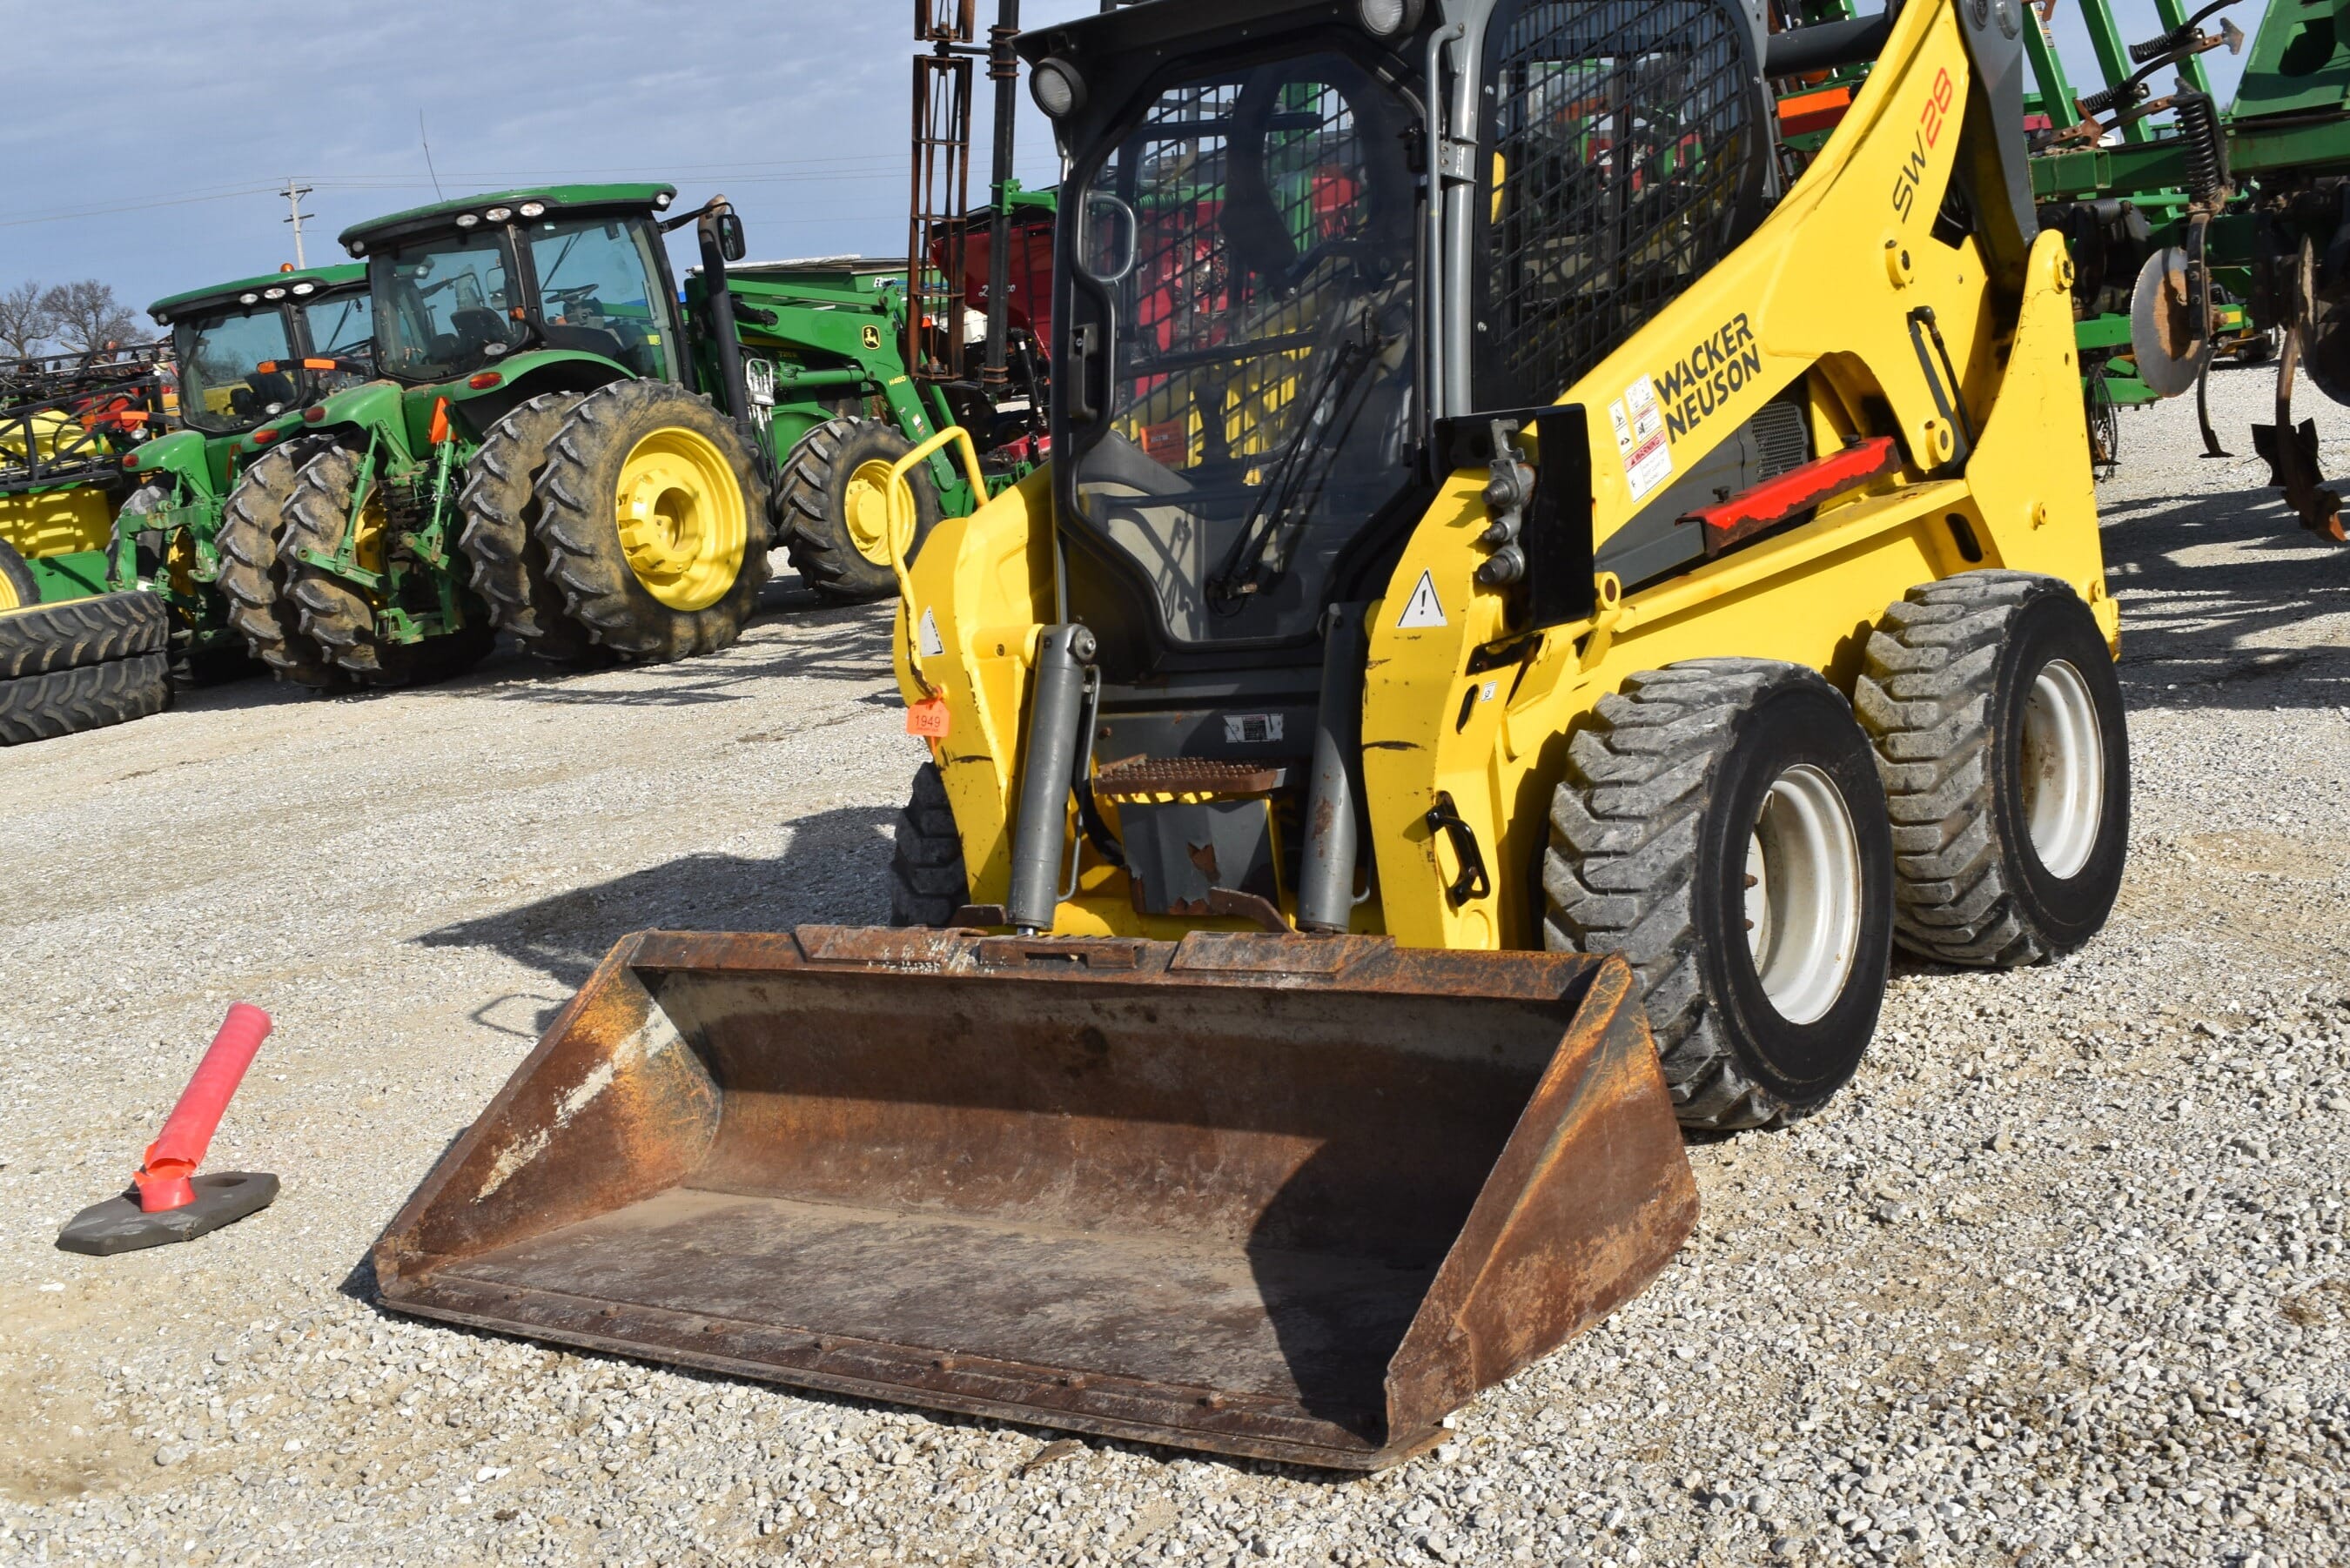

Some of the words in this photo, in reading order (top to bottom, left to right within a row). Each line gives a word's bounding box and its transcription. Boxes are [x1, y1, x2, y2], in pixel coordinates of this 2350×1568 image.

[1653, 312, 1755, 405] WACKER
[1664, 344, 1762, 445] NEUSON
[916, 715, 941, 727] 1949
